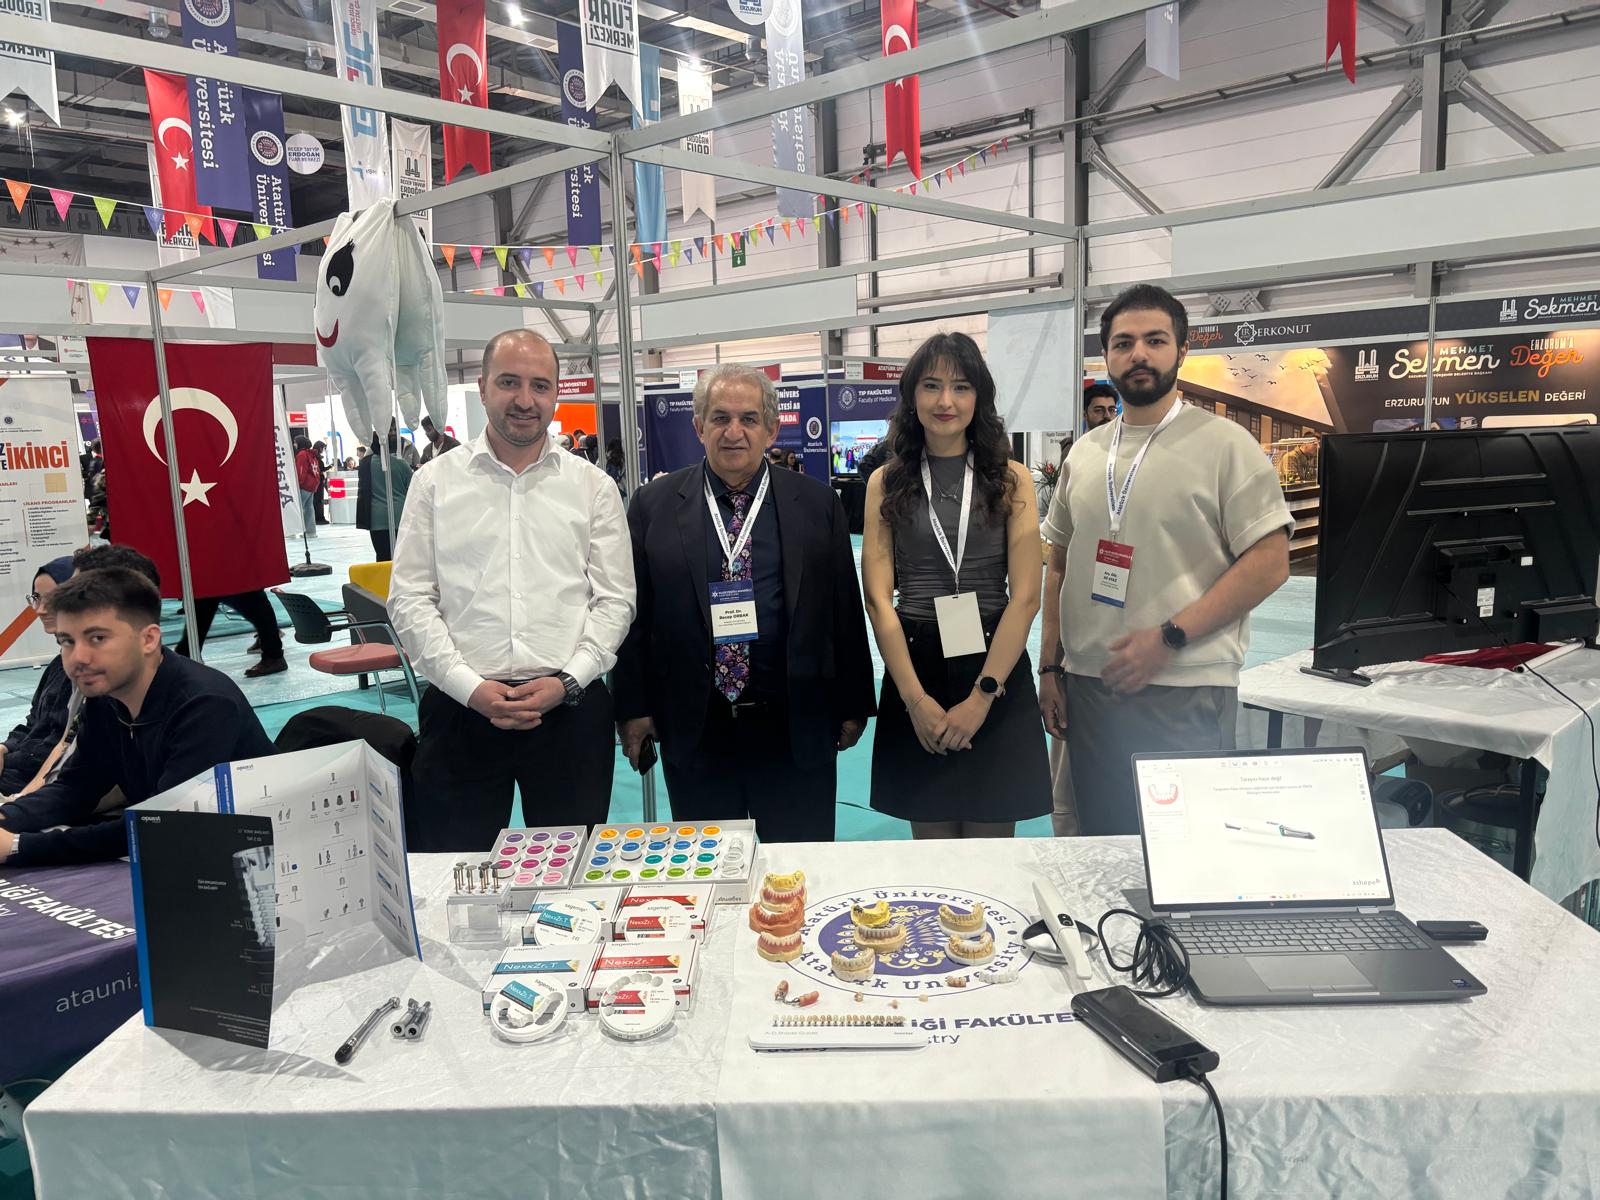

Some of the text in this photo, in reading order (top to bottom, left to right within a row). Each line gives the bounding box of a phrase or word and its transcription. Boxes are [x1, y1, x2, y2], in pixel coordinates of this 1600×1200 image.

[271, 175, 287, 235] Atatürk
[1524, 297, 1600, 319] Sekmen
[1560, 295, 1598, 303] MEHMET
[1258, 324, 1312, 337] ERKONUT
[1440, 344, 1494, 356] MEHMET
[1530, 337, 1575, 351] ERZURUM'A
[1510, 346, 1584, 378] Değer
[1384, 389, 1586, 408] ERZURU'UN YÜKSELEN DEĞERİ
[6, 441, 69, 470] İKİNCİ
[873, 889, 1017, 929] Üniverstesi
[955, 1012, 1075, 1029] FAKÜLTE
